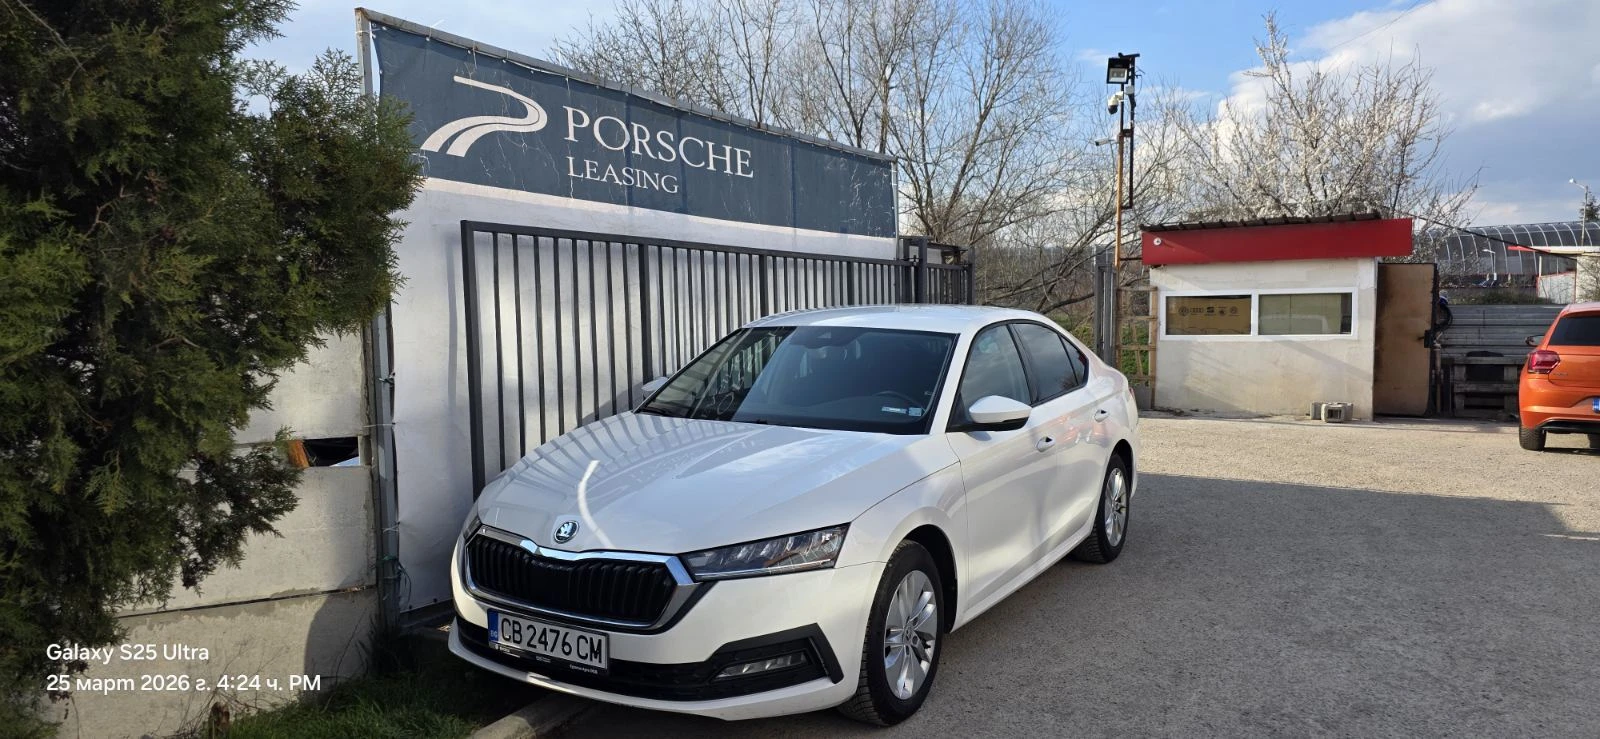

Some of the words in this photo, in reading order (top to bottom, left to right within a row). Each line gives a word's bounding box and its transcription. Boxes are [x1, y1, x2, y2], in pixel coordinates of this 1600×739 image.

[563, 105, 754, 178] PORSCHE
[566, 156, 679, 194] LEASING
[501, 617, 522, 645] CB
[526, 624, 573, 656] 2476
[576, 635, 602, 664] CM
